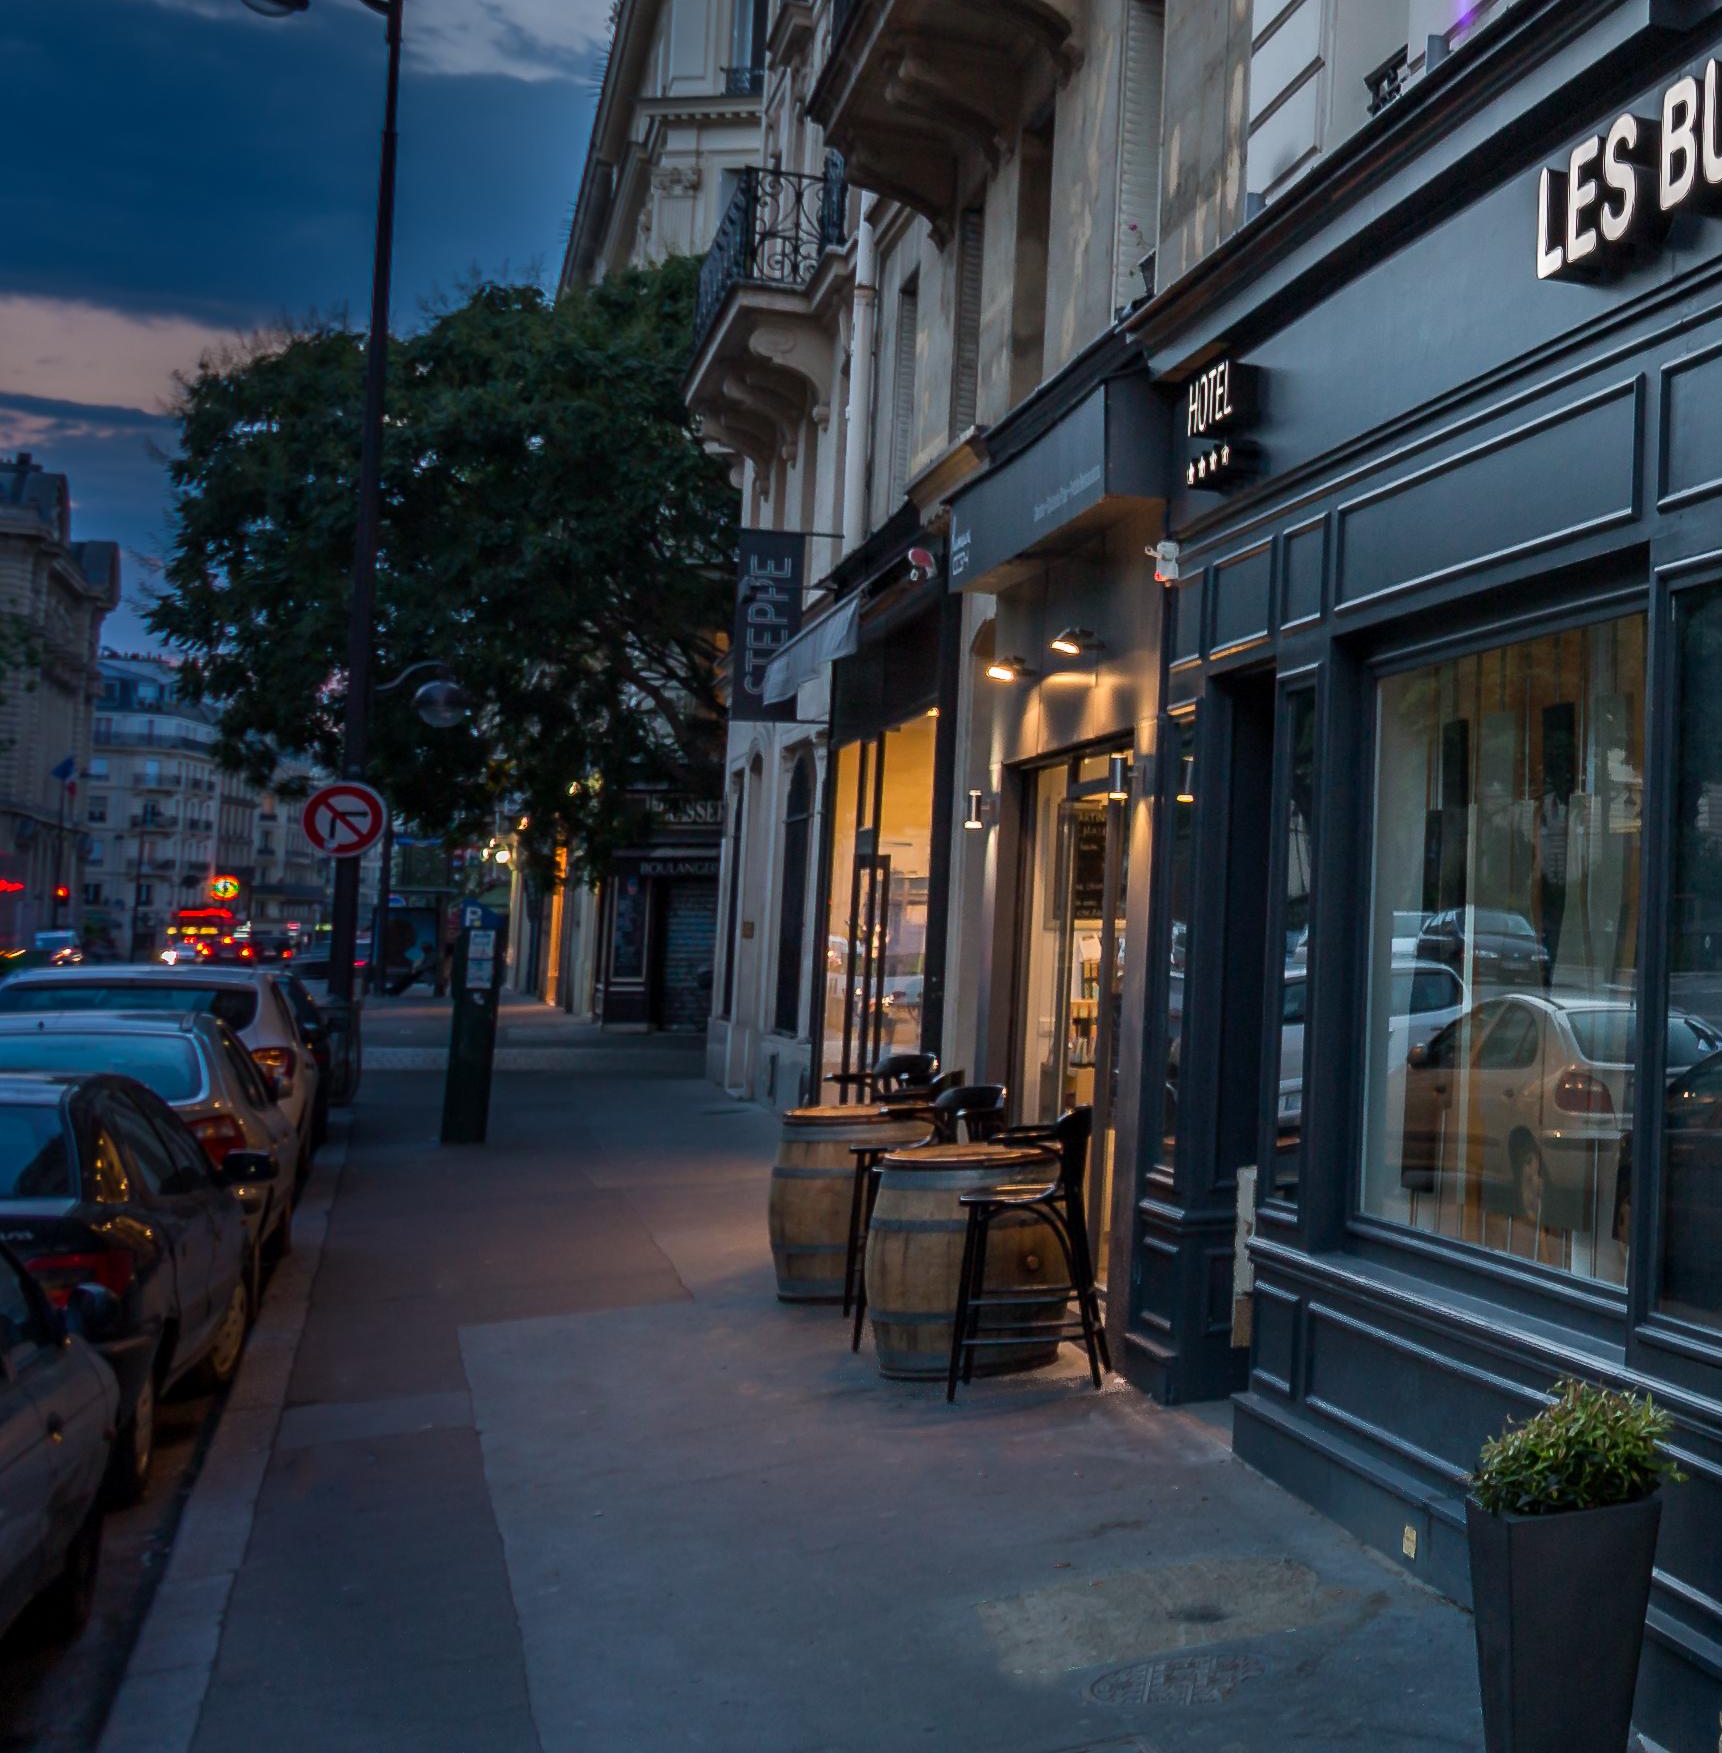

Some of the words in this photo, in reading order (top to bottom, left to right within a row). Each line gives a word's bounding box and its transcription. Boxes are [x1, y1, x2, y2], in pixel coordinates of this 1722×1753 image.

[1536, 112, 1638, 280] LES
[1187, 359, 1233, 438] HOTEL
[464, 904, 483, 927] P
